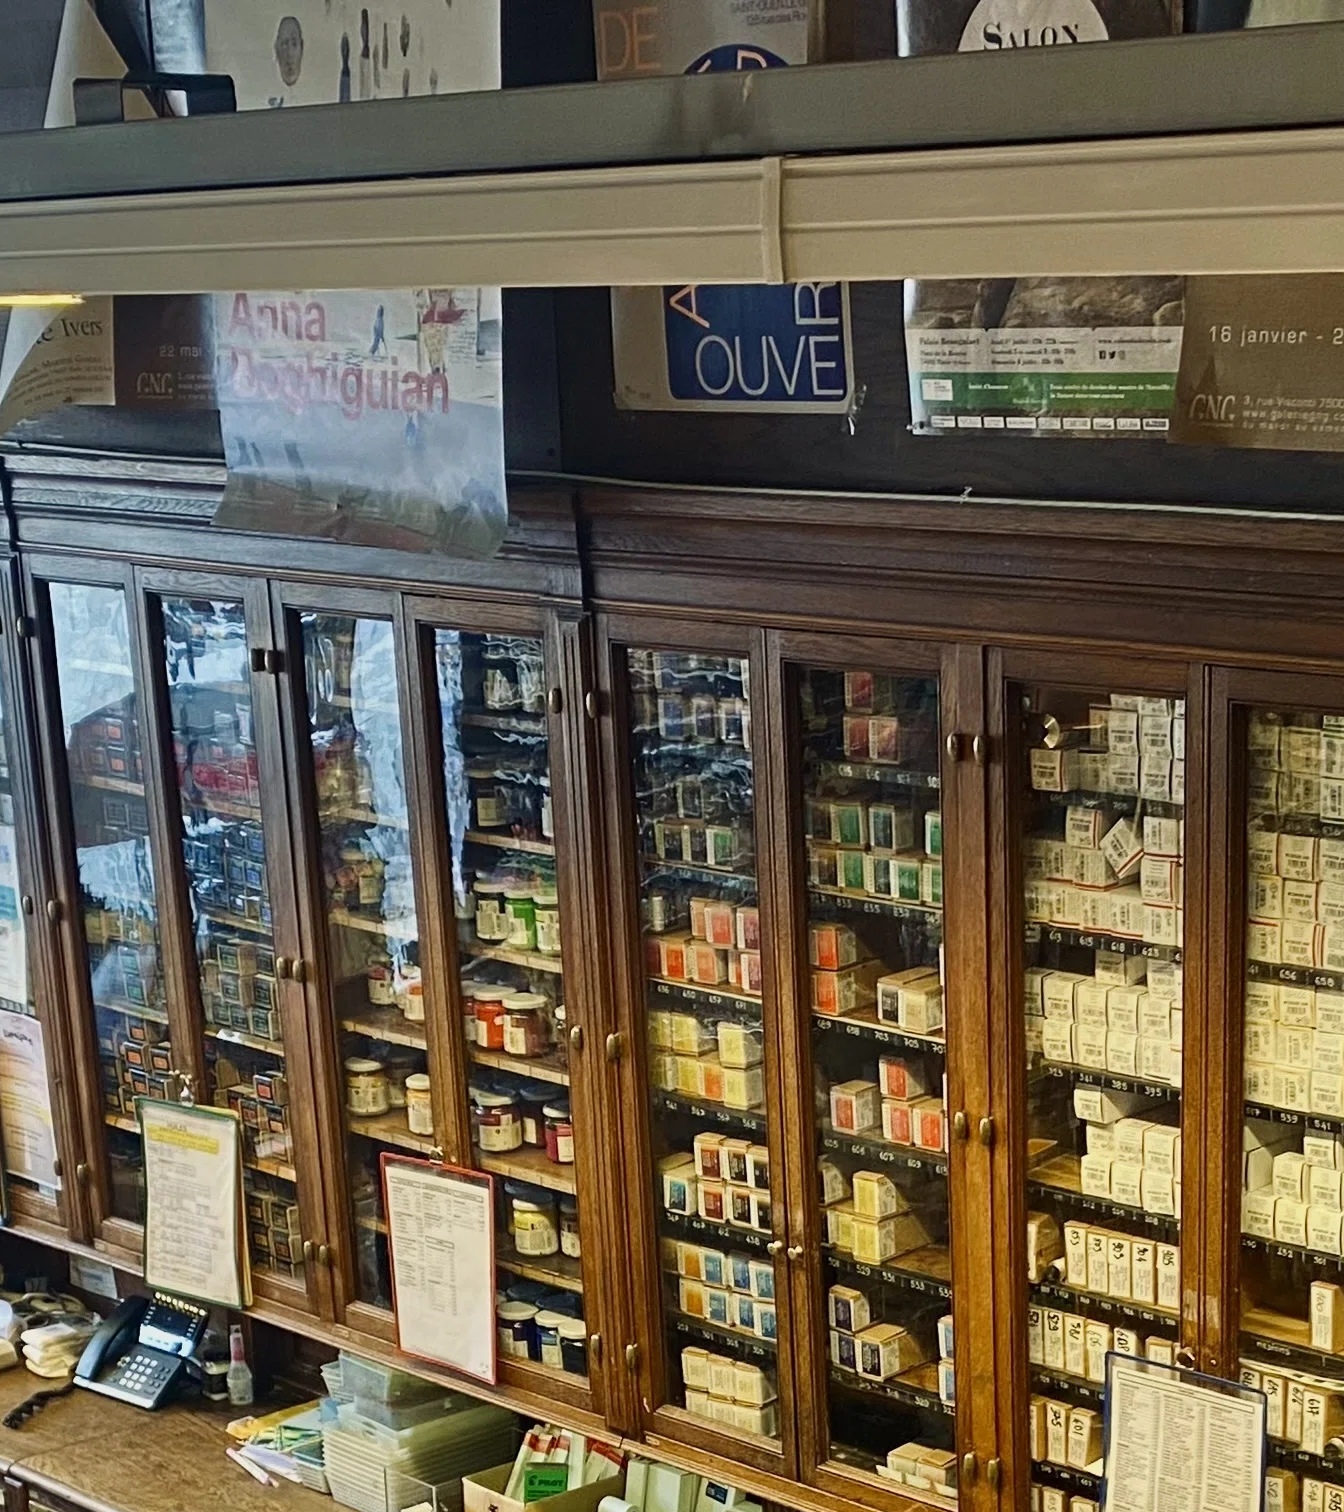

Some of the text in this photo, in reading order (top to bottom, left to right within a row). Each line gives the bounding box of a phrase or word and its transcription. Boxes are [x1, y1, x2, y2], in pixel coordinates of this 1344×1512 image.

[229, 292, 327, 341] Anna
[60, 318, 104, 338] Ivers
[1209, 325, 1232, 343] 16
[1240, 326, 1307, 348] janvier
[1279, 968, 1297, 981] 656
[1279, 1112, 1298, 1124] 539
